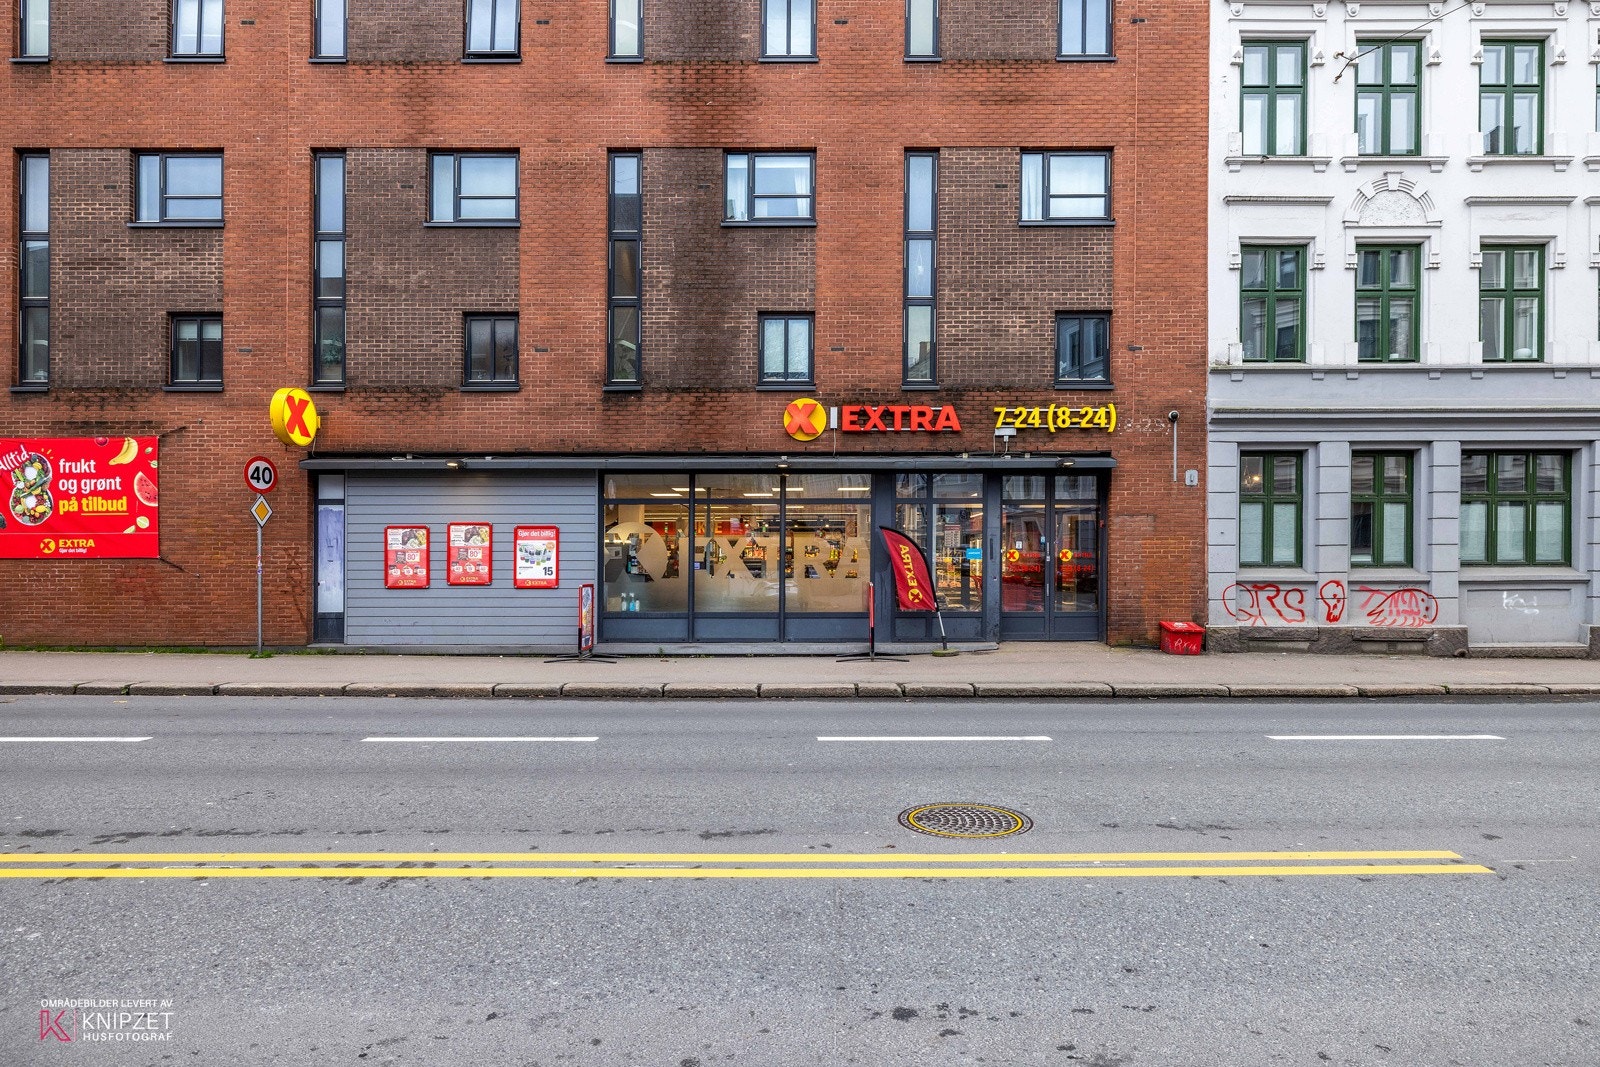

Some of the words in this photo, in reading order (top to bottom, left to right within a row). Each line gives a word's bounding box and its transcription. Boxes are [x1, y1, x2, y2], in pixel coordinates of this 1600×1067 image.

[841, 405, 962, 431] EXTRA
[993, 407, 1042, 428] 7-24
[1047, 403, 1117, 432] (8-24)
[59, 459, 96, 473] frukt
[250, 466, 272, 484] 40
[59, 478, 78, 494] og
[81, 476, 122, 494] grønt
[59, 496, 79, 514] på
[81, 496, 128, 511] tilbud
[59, 539, 95, 547] EXTRA
[679, 537, 871, 578] EXTRA
[543, 566, 554, 576] 15
